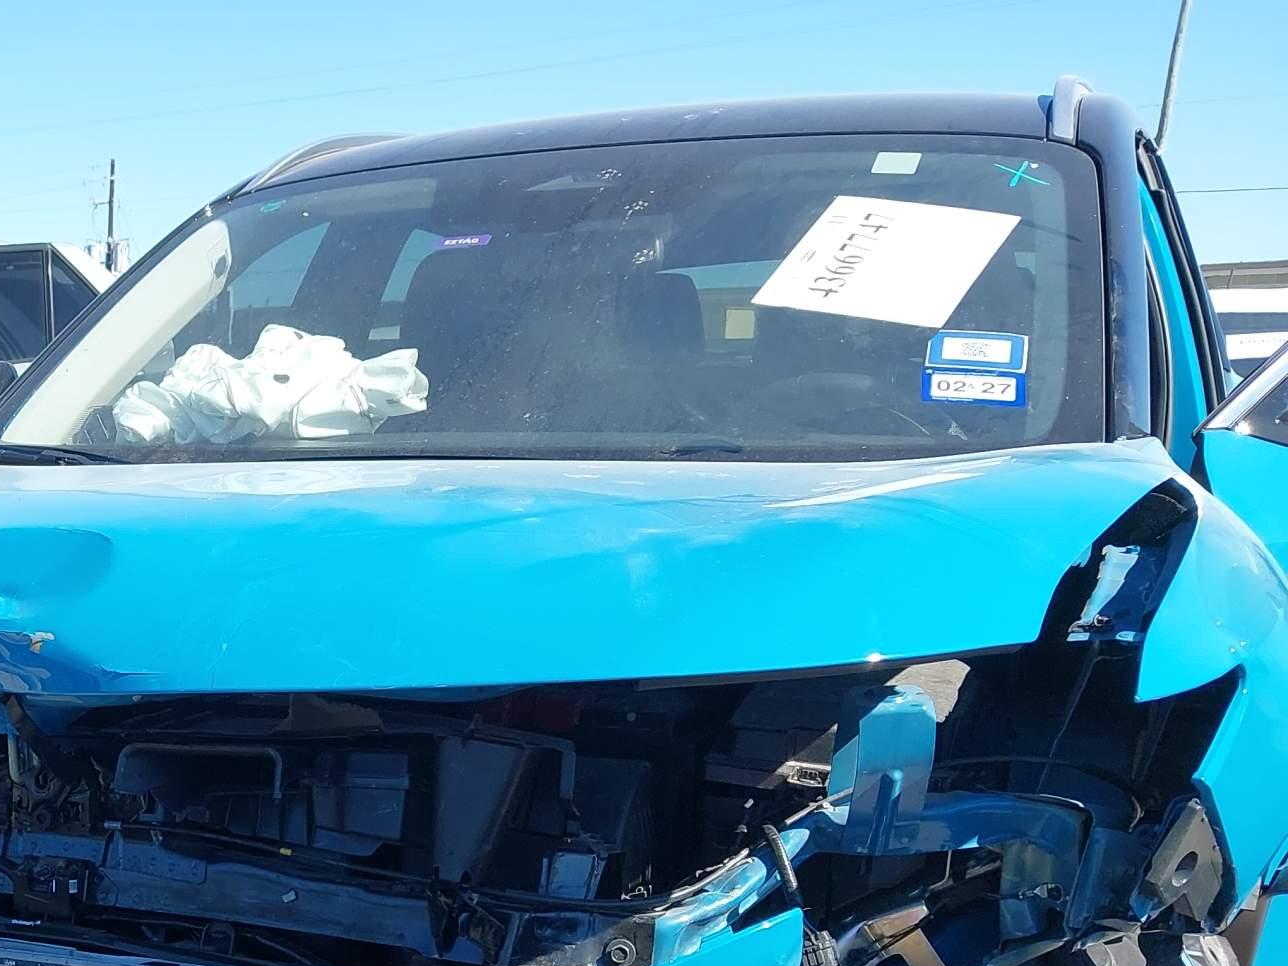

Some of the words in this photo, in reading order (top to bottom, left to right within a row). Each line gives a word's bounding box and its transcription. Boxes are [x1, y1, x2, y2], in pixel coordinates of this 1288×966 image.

[808, 213, 895, 298] 43667747
[937, 379, 966, 393] 02
[981, 381, 1012, 395] 27
